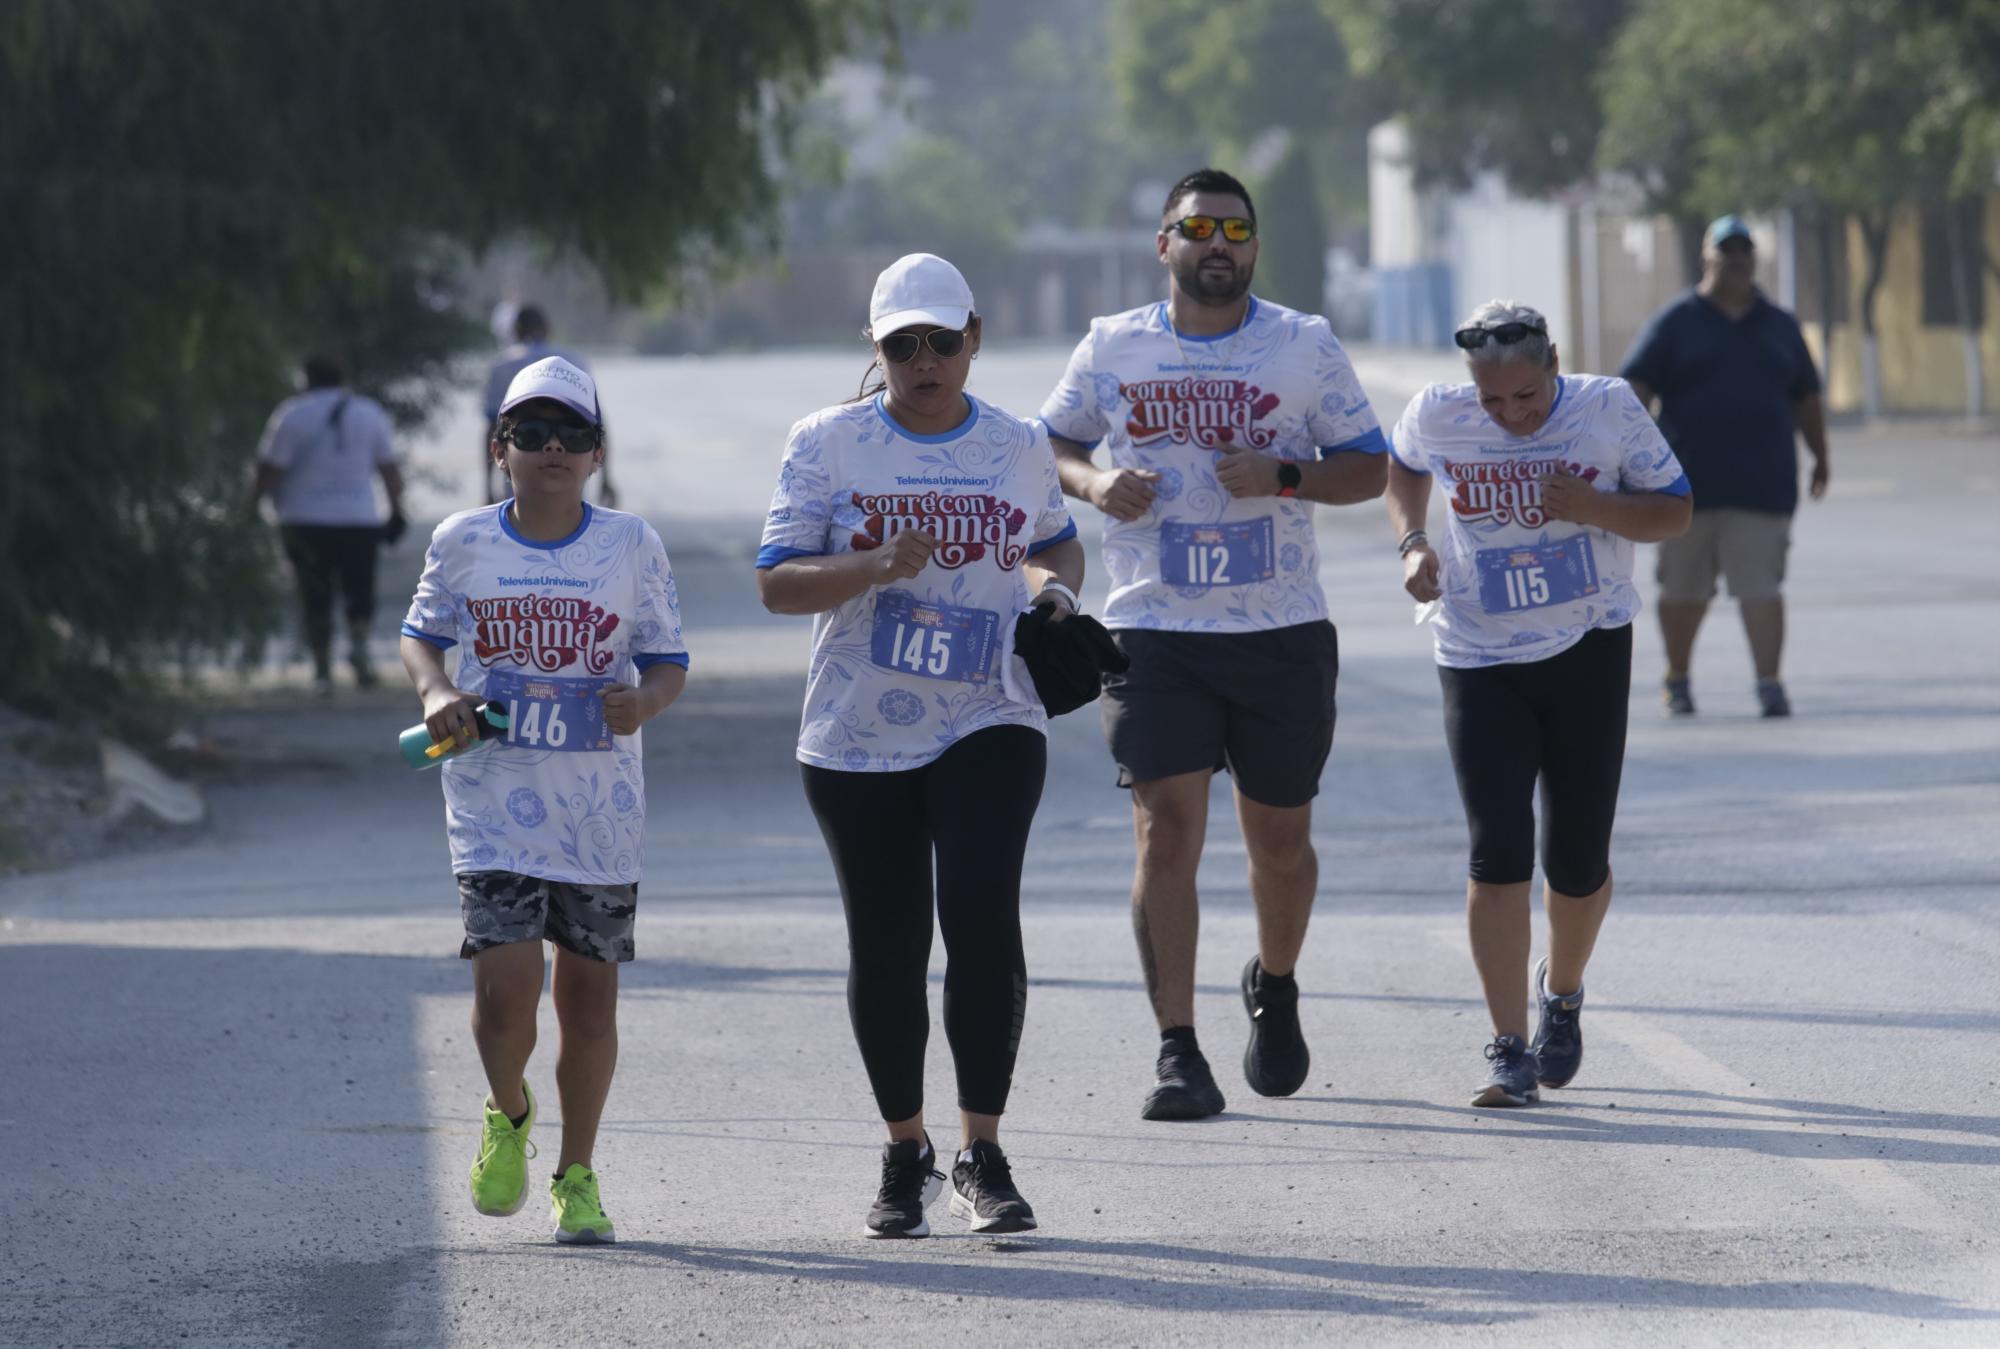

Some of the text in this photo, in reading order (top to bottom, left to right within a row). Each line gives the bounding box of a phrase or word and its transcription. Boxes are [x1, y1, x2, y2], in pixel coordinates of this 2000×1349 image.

[1192, 381, 1235, 400] con
[1133, 390, 1270, 449] mamá
[896, 476, 989, 486] TelevisaUnivision
[938, 495, 987, 514] con
[1457, 480, 1544, 528] mam
[497, 577, 588, 588] TelevisaUnivision
[1188, 545, 1231, 584] 112
[1504, 567, 1550, 608] 115
[536, 599, 580, 619] con
[478, 613, 606, 674] mamá
[891, 623, 952, 675] 145
[507, 699, 567, 747] 146
